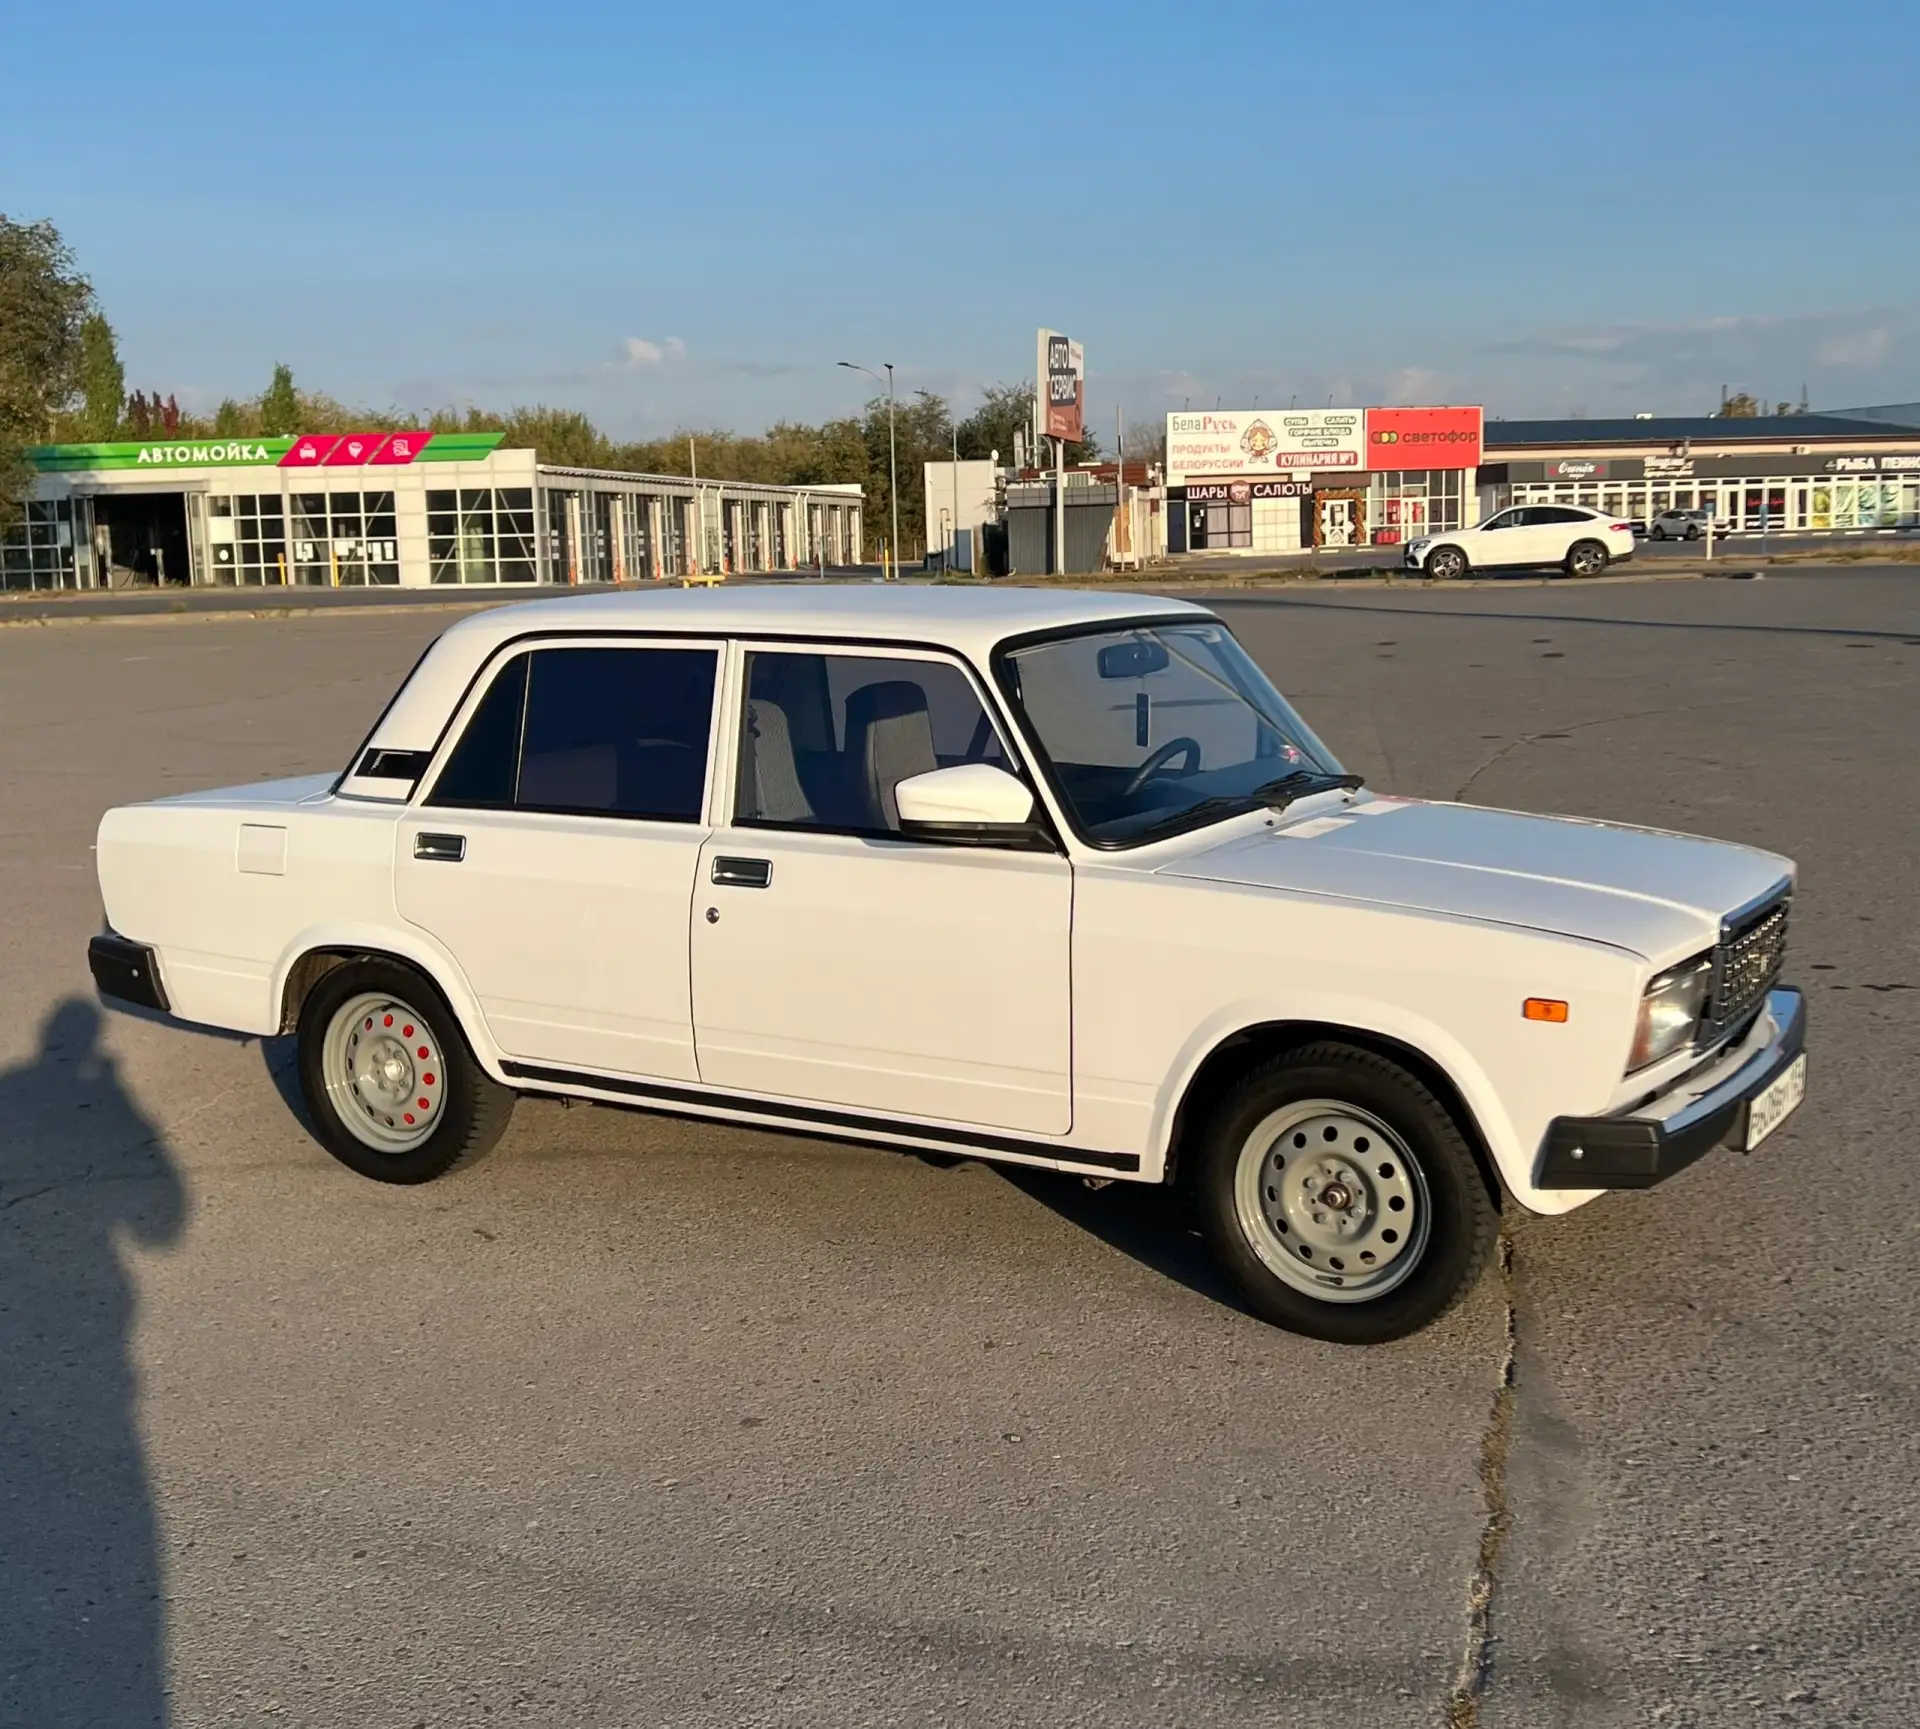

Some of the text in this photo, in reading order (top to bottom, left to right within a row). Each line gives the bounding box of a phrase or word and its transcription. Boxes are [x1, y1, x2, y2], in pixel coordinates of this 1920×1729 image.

[1050, 343, 1068, 369] АВТО
[1051, 374, 1077, 401] СЕРВИС
[1402, 429, 1477, 444] светофор
[137, 443, 270, 464] АВТОМОЙКА
[1172, 444, 1231, 454] ПРОДУКТЫ
[1172, 460, 1244, 470] БЕЛОРУССИИ
[1281, 453, 1338, 466] КУЛИНАРИЯ
[1836, 457, 1876, 471] РЫБА
[1187, 487, 1228, 499] ШАРЫ
[1253, 483, 1313, 497] САЛЮТЫ
